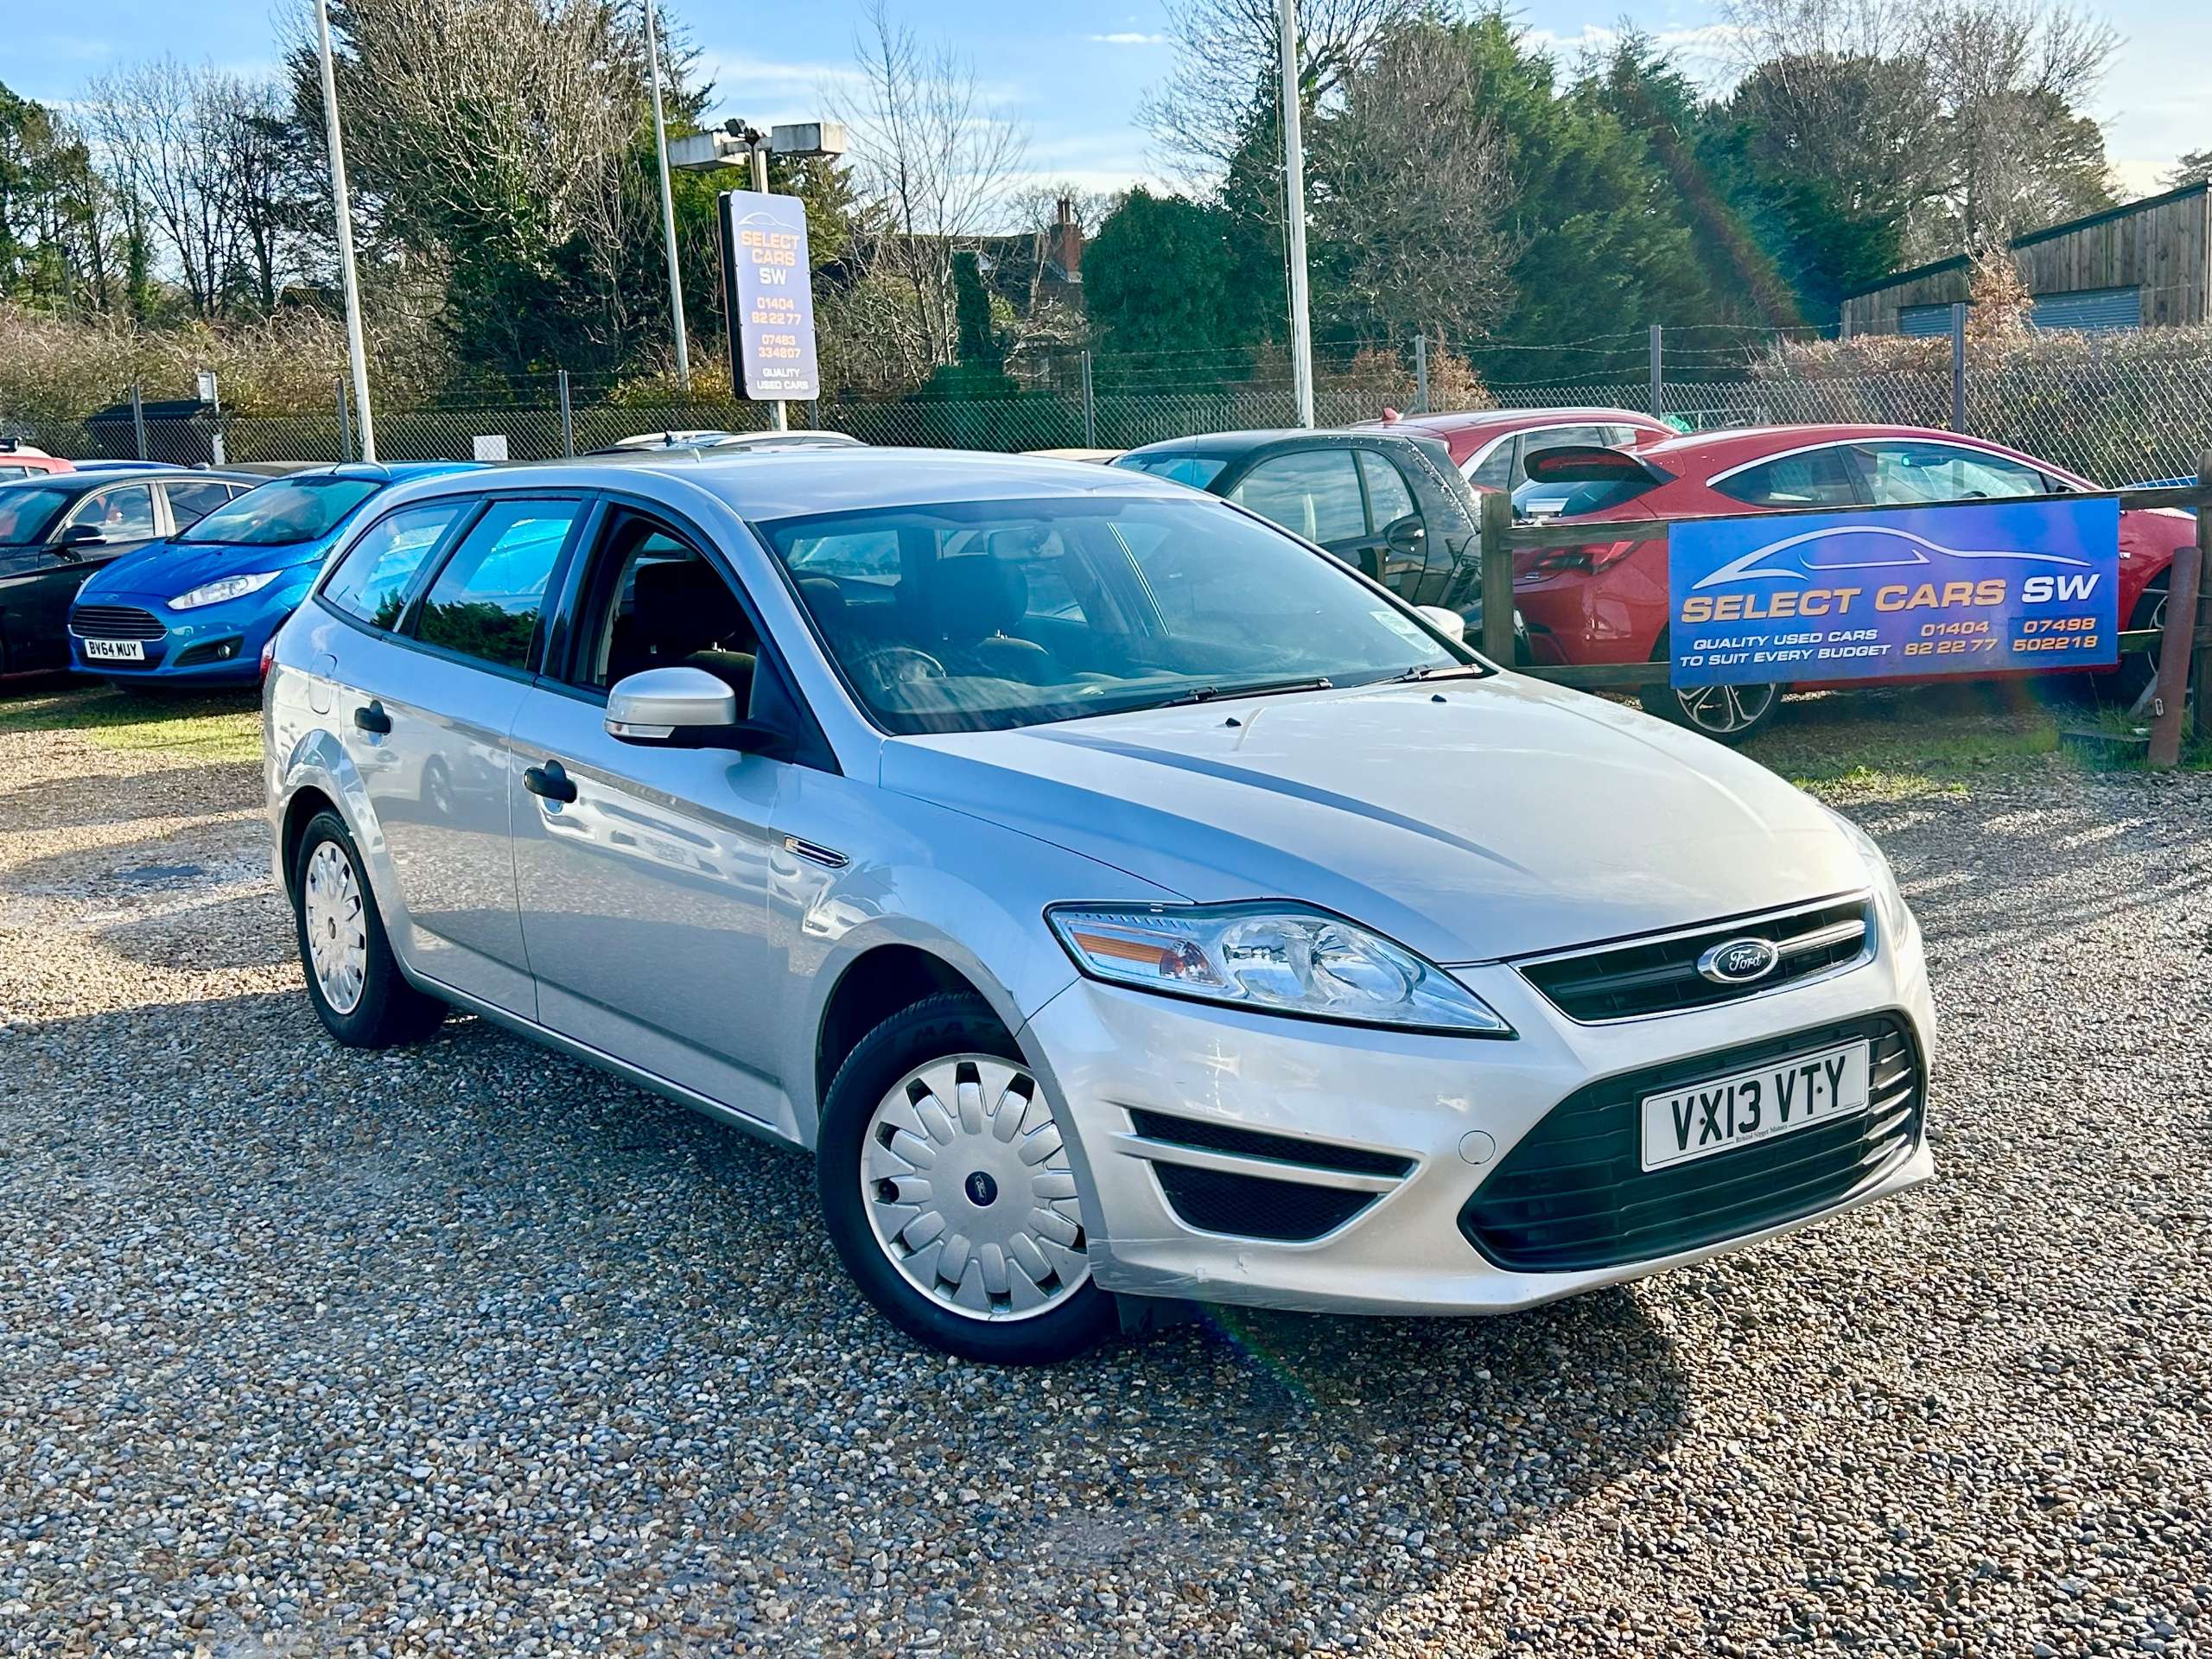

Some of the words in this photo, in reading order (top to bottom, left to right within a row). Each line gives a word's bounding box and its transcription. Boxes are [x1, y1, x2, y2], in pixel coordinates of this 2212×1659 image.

[741, 231, 801, 250] SELECT
[752, 249, 796, 267] CARS
[760, 267, 786, 285] SW
[757, 297, 794, 310] 01404
[761, 334, 796, 346] 07483
[762, 368, 800, 378] QUALITY
[757, 380, 782, 390] USED
[784, 381, 809, 390] CARS
[1681, 588, 1862, 623] SELECT
[1875, 579, 2007, 612] CARS
[2021, 574, 2101, 604] SW
[1921, 620, 1990, 637] 01404
[2024, 617, 2097, 634] 07498
[1693, 635, 1769, 651] QUALITY
[1774, 632, 1823, 645] USED
[1827, 629, 1878, 643] CARS
[2012, 635, 2098, 652] 502218
[88, 641, 114, 656] BV64
[116, 643, 137, 657] MUY
[1680, 655, 1703, 667] TO
[1708, 652, 1749, 666] SUIT
[1753, 648, 1814, 664] EVERY
[1818, 644, 1891, 659] BUDGET
[1728, 949, 1763, 972] Ford
[1671, 1080, 1761, 1151] VX13
[1775, 1056, 1846, 1122] VTY
